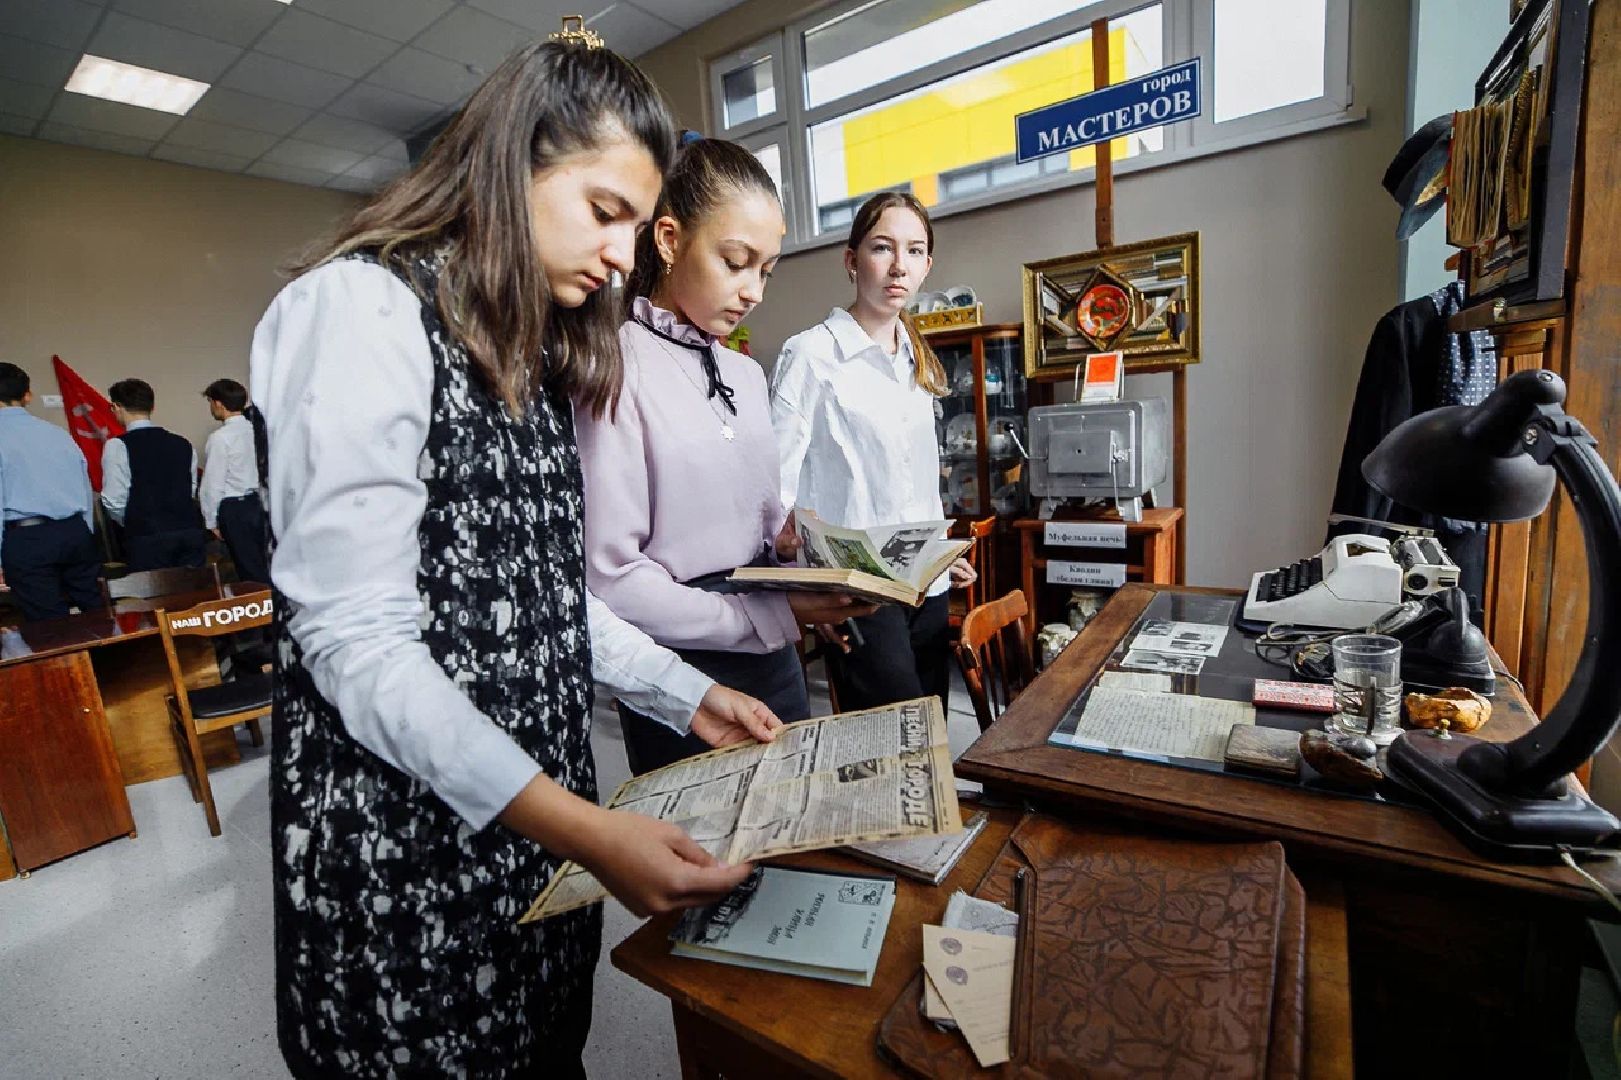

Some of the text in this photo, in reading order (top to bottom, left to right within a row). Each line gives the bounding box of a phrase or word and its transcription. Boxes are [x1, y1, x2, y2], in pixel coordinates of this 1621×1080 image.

[1143, 69, 1190, 93] город
[1037, 90, 1192, 151] МАСТЕРОВ
[203, 600, 273, 627] ГОРОД
